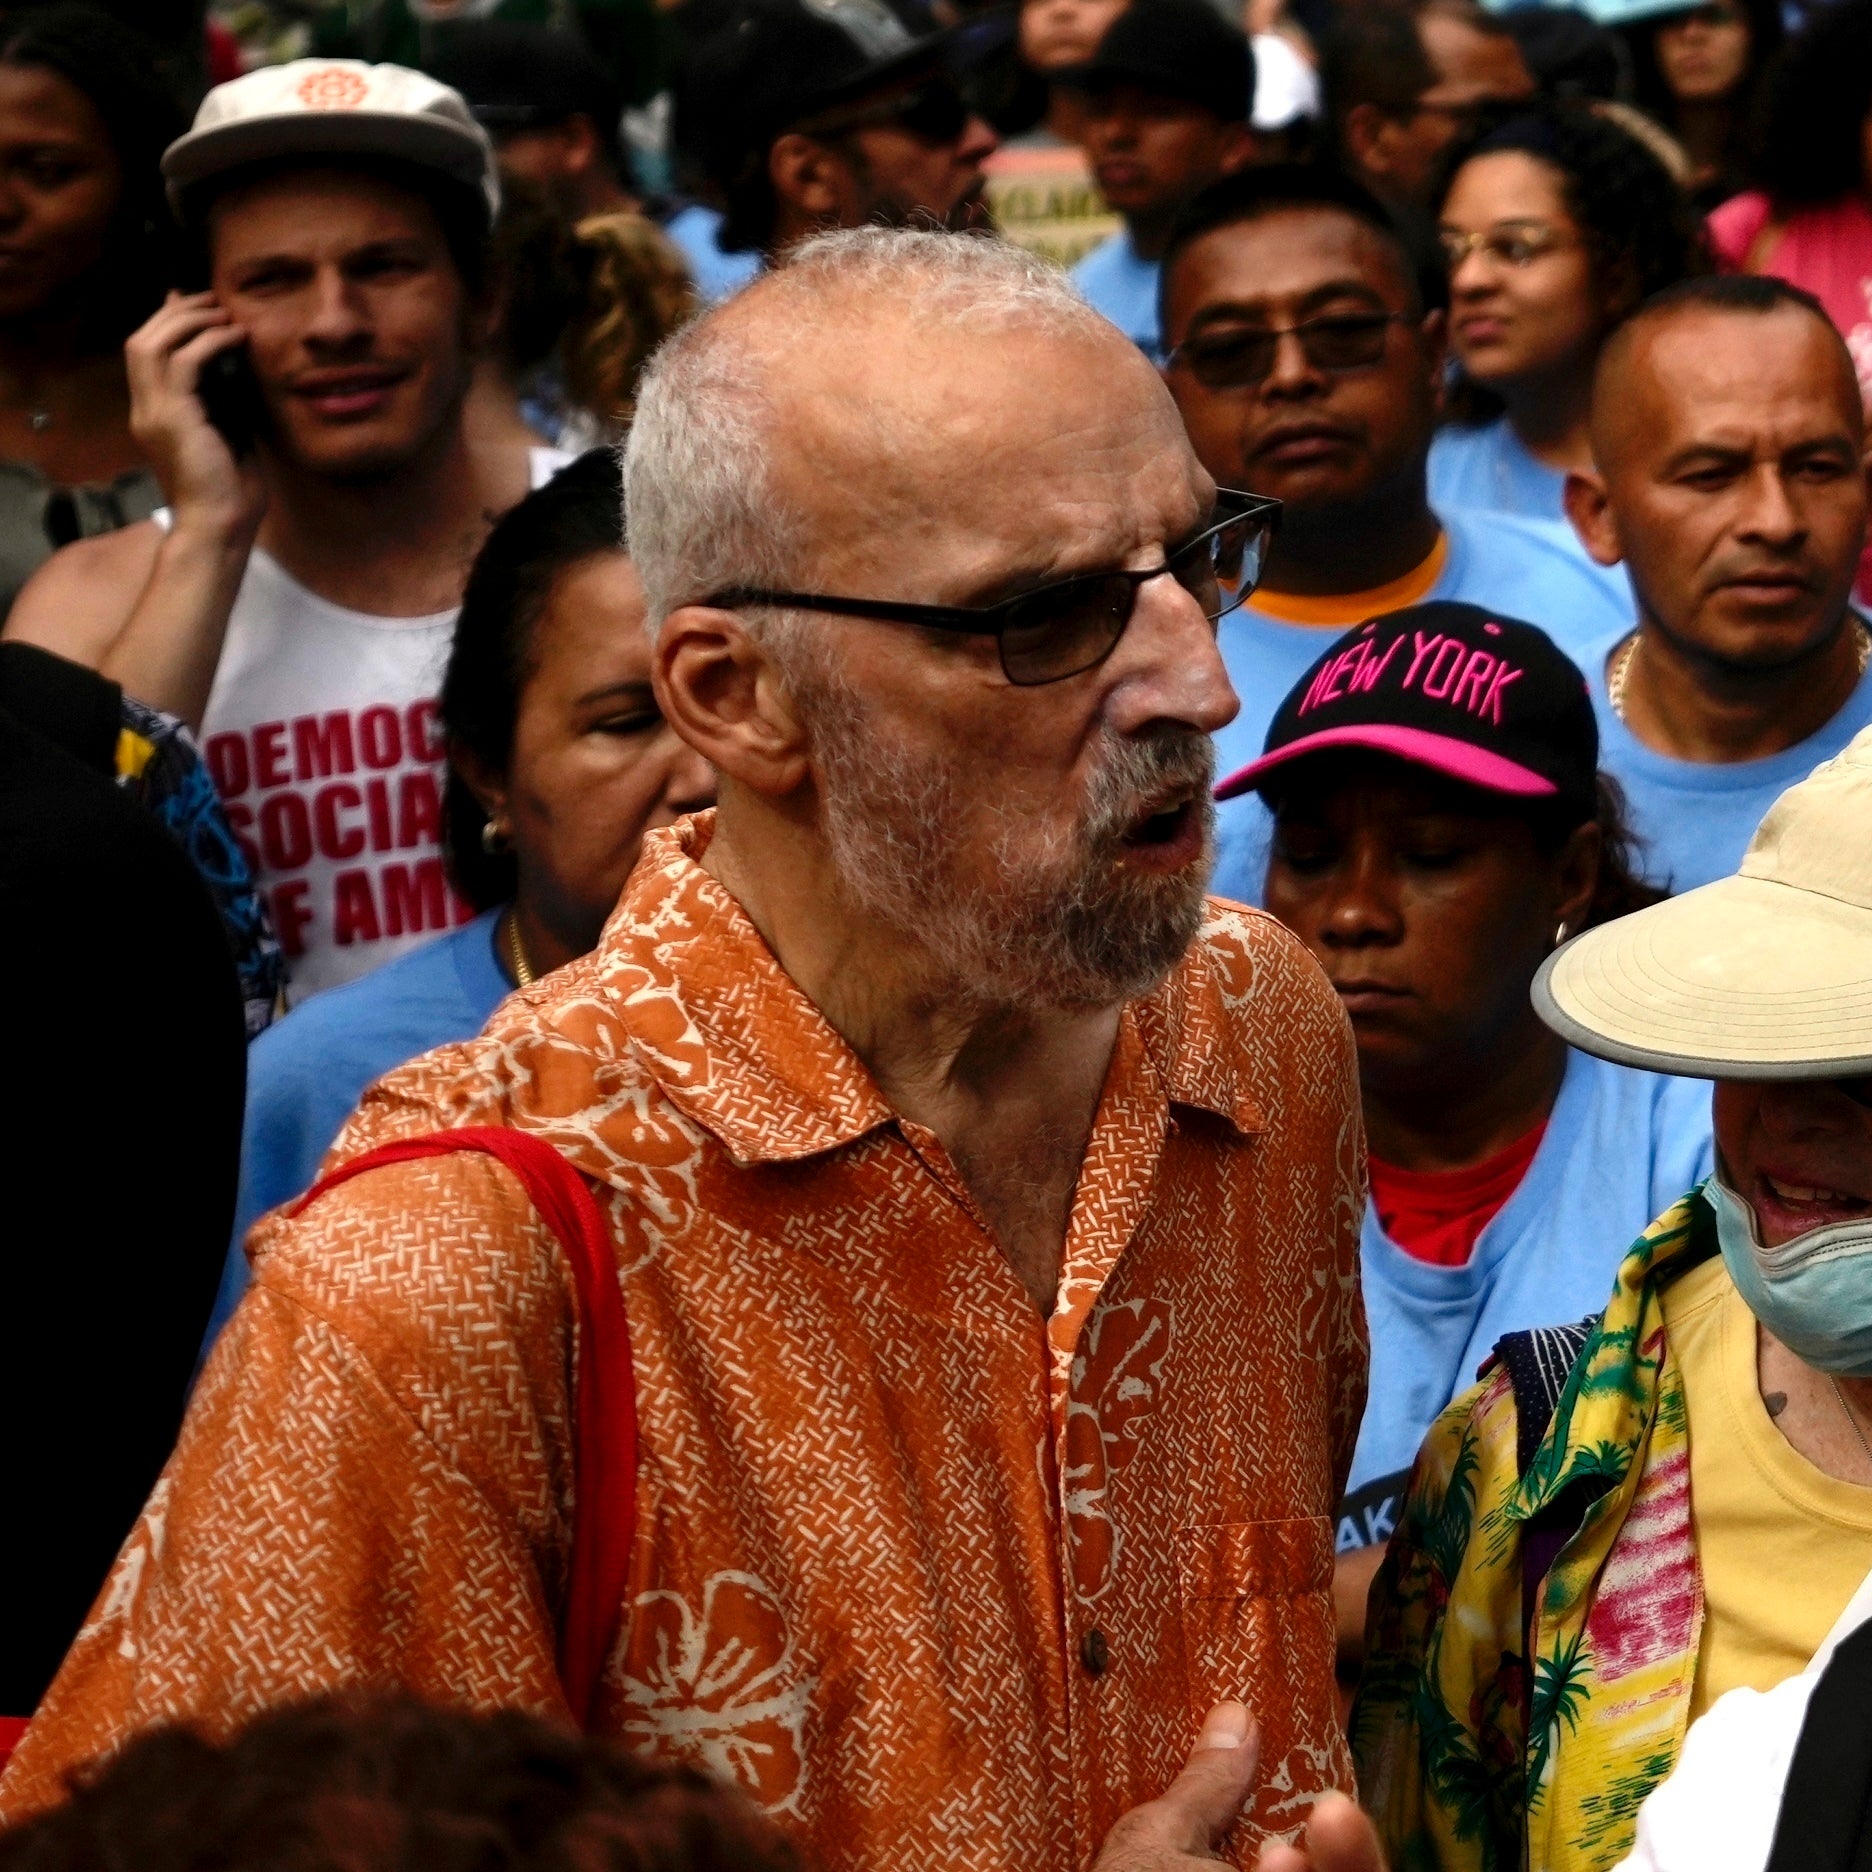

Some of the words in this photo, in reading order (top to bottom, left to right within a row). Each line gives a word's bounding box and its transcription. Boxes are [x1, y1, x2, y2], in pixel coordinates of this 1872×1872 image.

[1298, 637, 1407, 718] NEW
[1402, 630, 1524, 727] YORK
[206, 699, 446, 799] DEMOC
[224, 769, 442, 876] SOCIA
